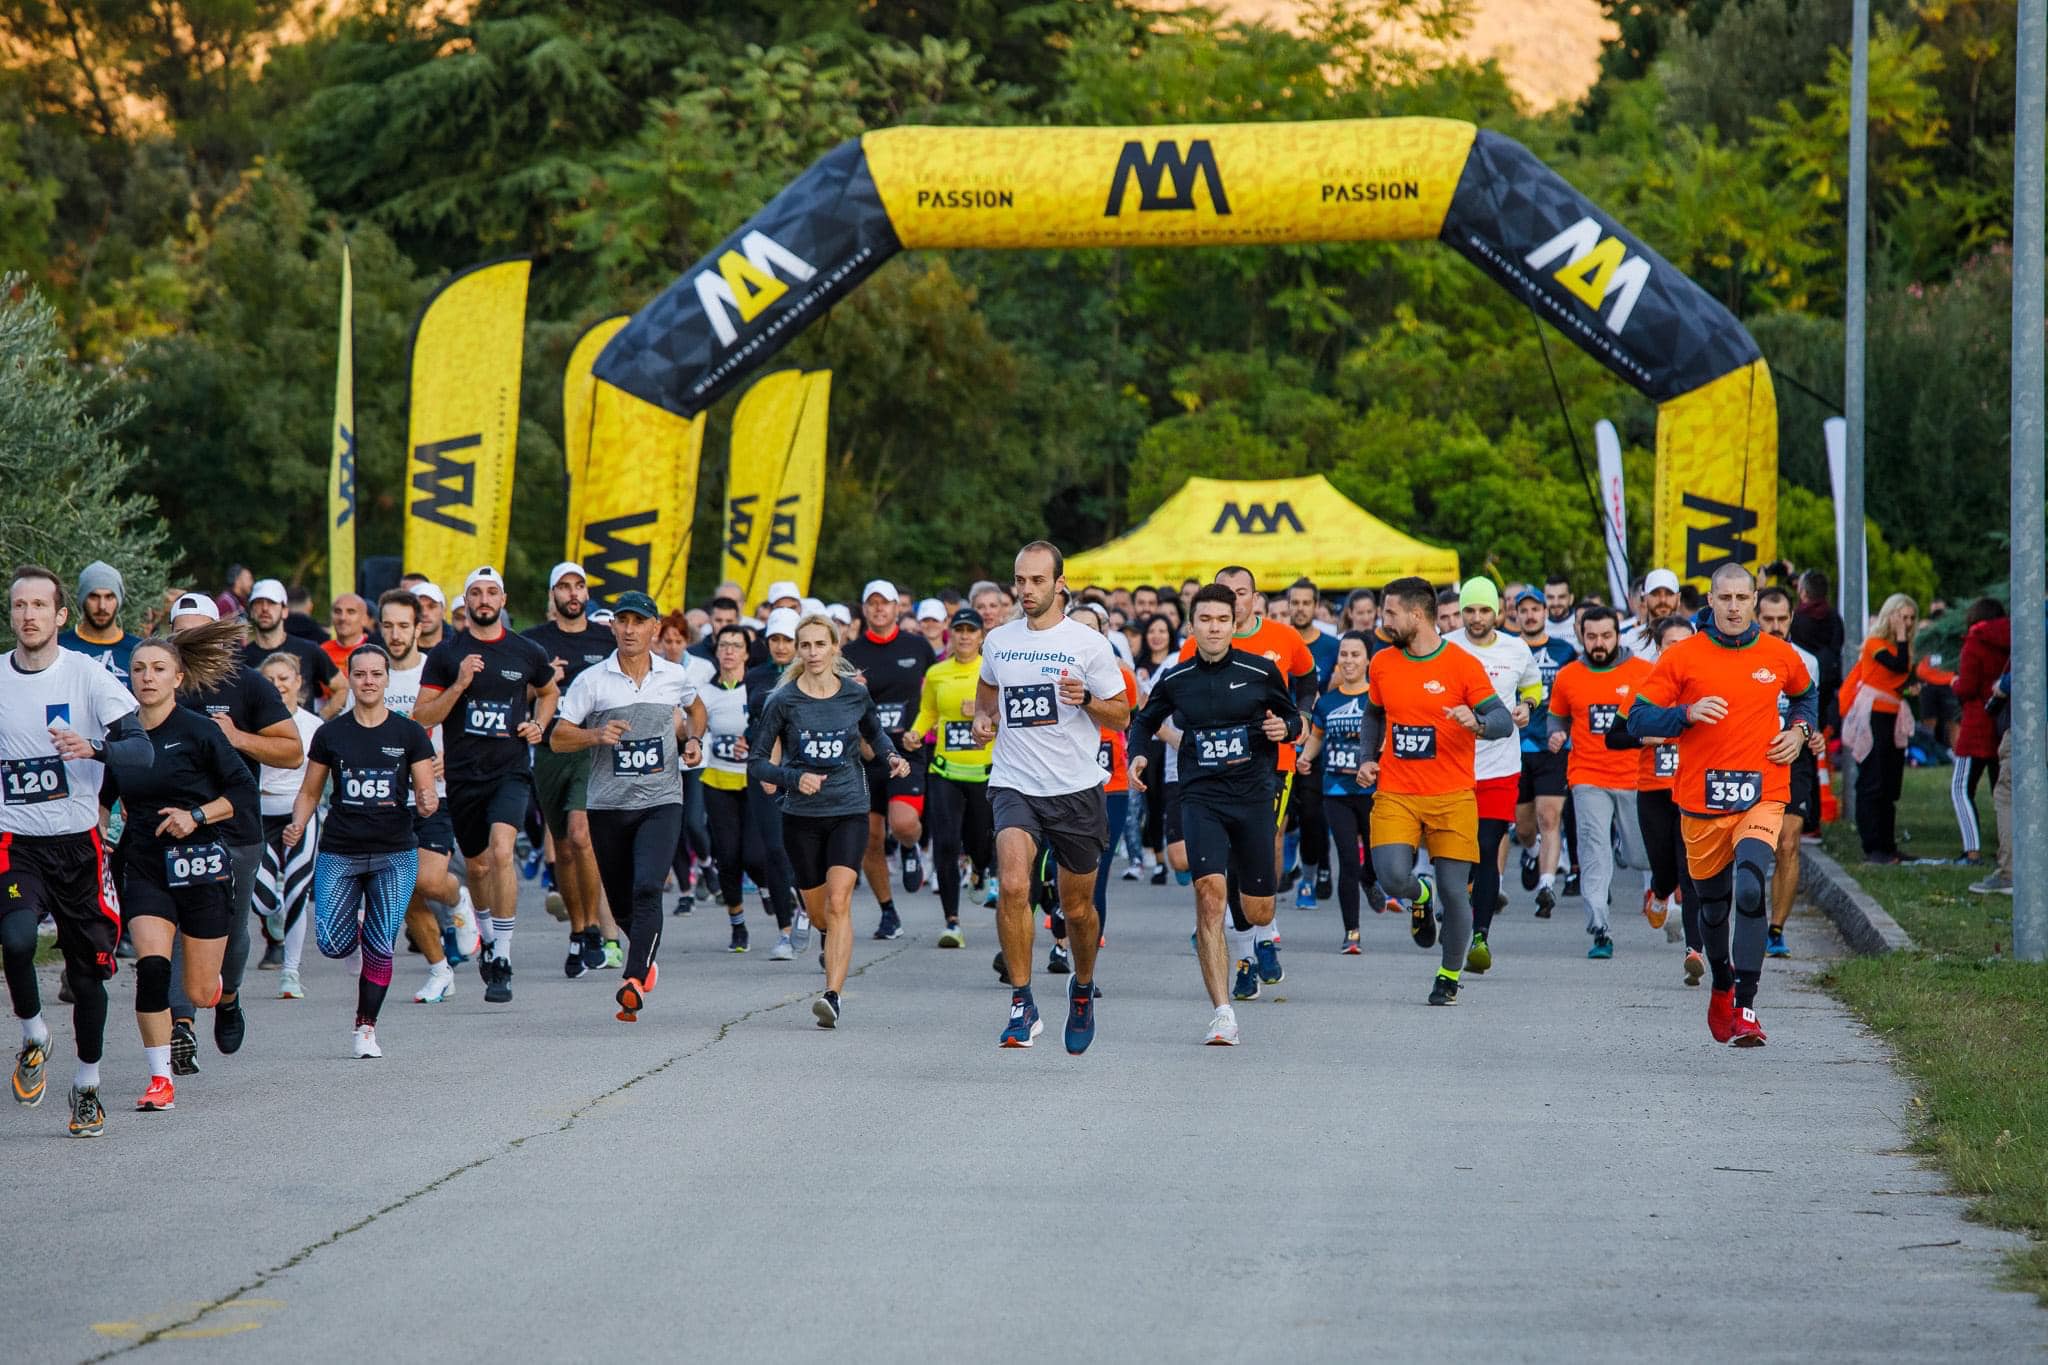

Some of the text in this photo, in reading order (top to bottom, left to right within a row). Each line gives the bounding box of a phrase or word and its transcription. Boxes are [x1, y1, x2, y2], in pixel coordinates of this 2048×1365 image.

[917, 190, 1014, 208] PASSION
[1322, 181, 1419, 202] PASSION
[993, 650, 1076, 664] #vjerujusebe
[1041, 666, 1060, 676] ERSTE
[1009, 696, 1050, 718] 228
[471, 710, 507, 730] 071
[804, 740, 844, 759] 439
[1201, 738, 1244, 759] 254
[1395, 734, 1430, 752] 357
[618, 748, 659, 768] 306
[1327, 751, 1357, 768] 181
[8, 770, 60, 795] 120
[346, 779, 391, 799] 065
[1711, 781, 1756, 801] 330
[174, 855, 223, 878] 083
